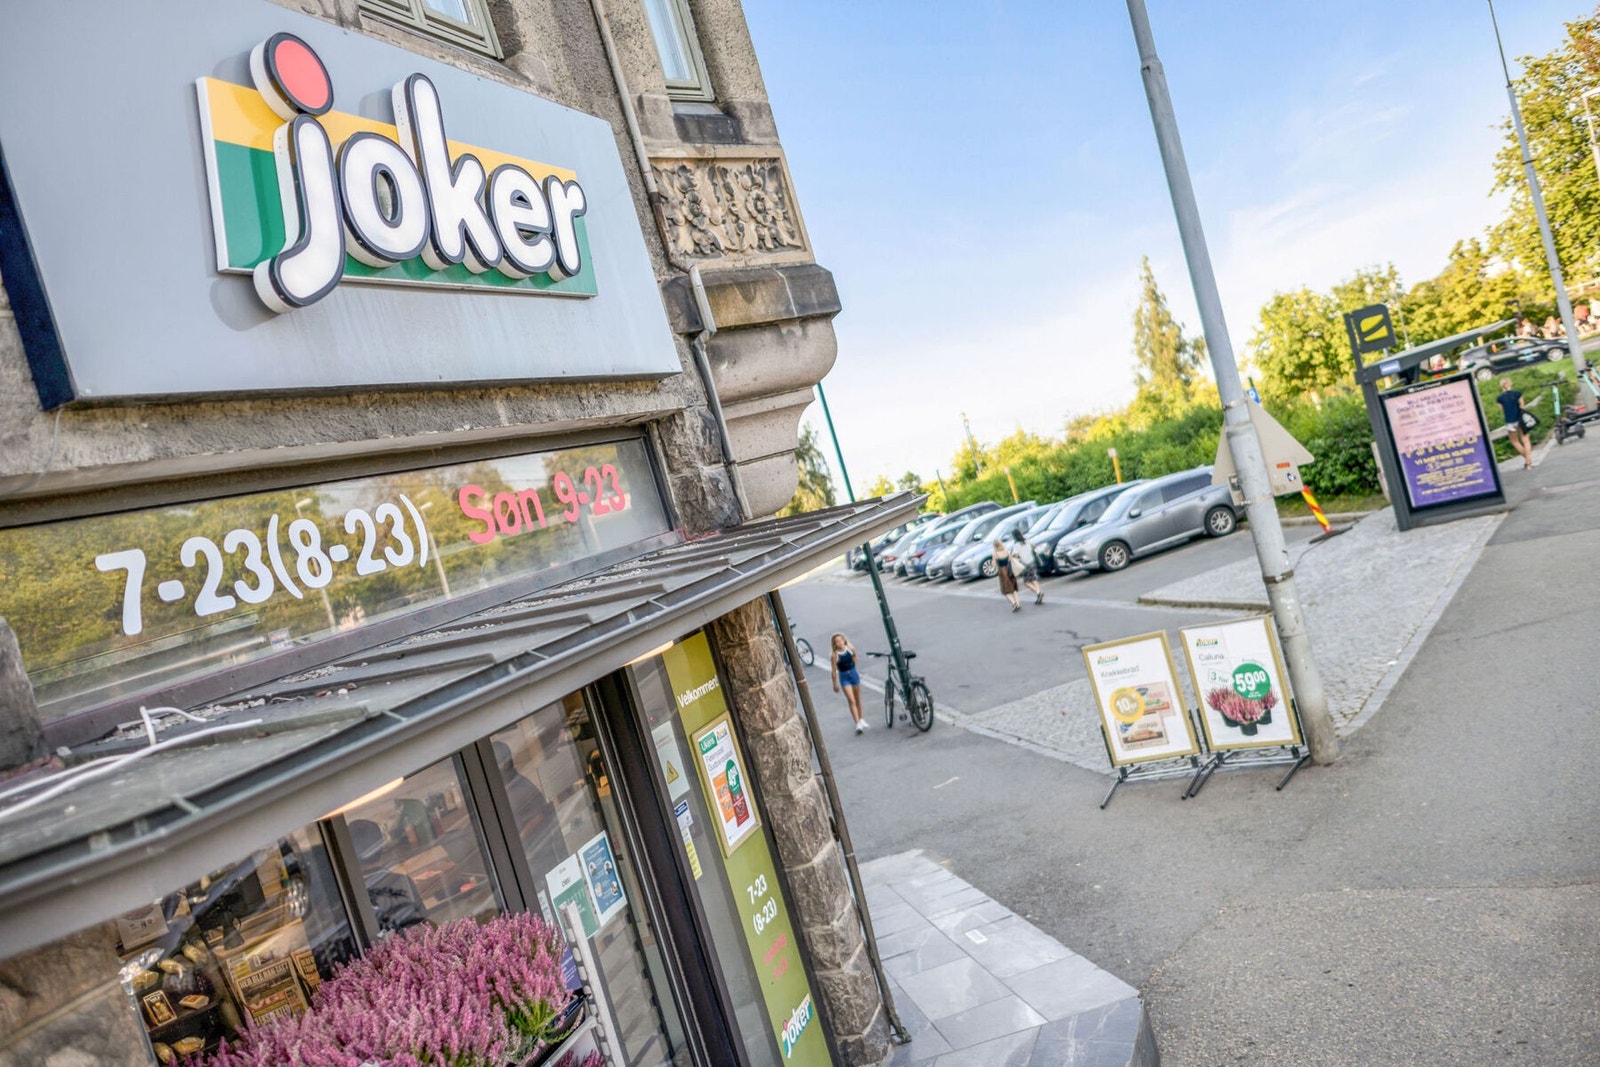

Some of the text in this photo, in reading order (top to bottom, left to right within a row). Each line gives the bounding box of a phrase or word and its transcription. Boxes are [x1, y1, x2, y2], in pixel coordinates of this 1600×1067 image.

[250, 32, 588, 313] joker
[459, 464, 625, 544] Søn 9-23
[747, 873, 767, 905] 7-23
[782, 997, 812, 1059] joker
